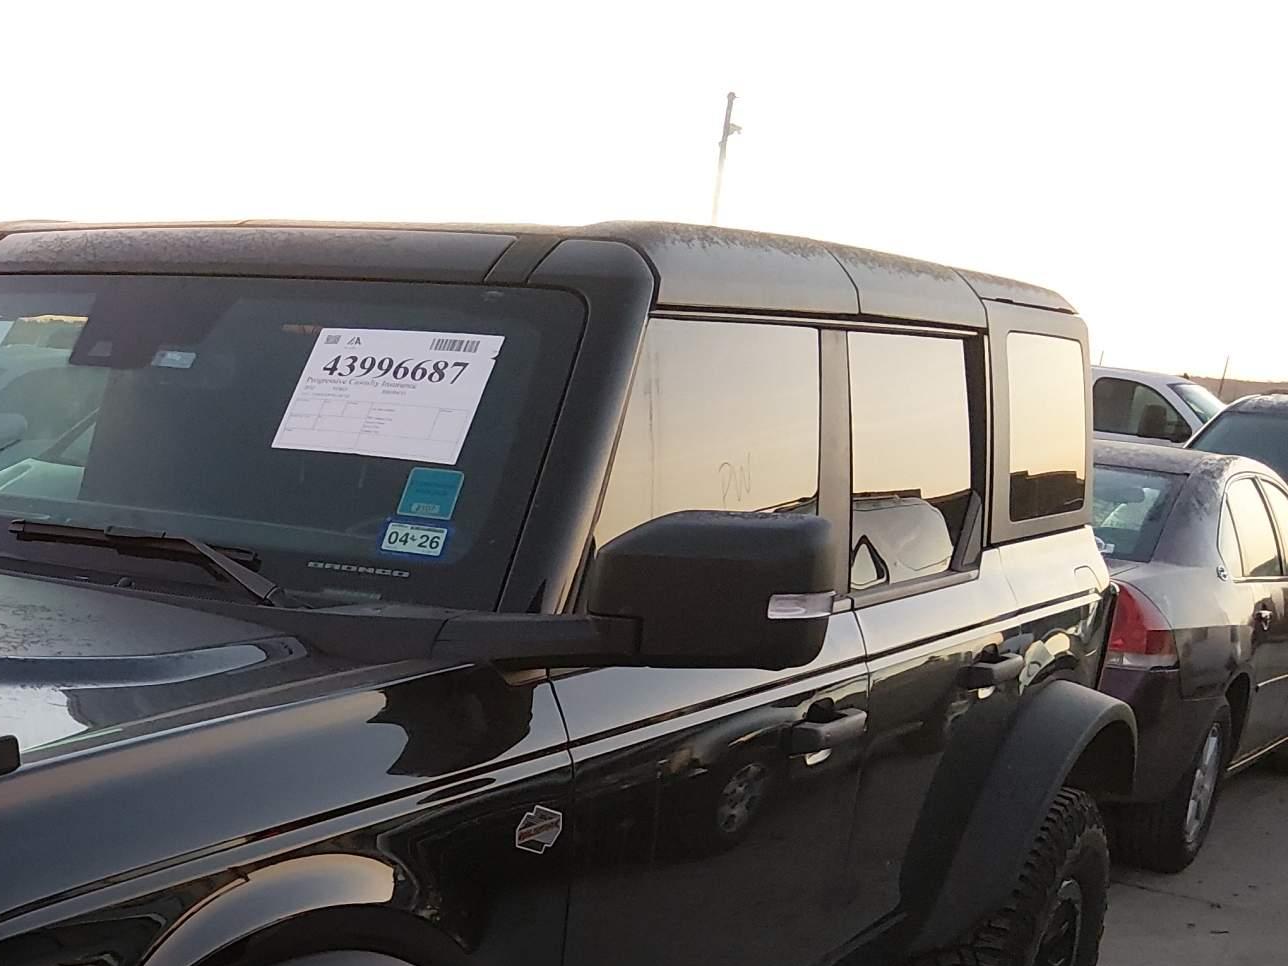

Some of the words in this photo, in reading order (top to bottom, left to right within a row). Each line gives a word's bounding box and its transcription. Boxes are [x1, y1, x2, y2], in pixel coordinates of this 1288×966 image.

[323, 355, 469, 384] 43996687
[388, 531, 410, 545] 04
[417, 535, 441, 550] 26
[307, 561, 410, 578] BRONCO
